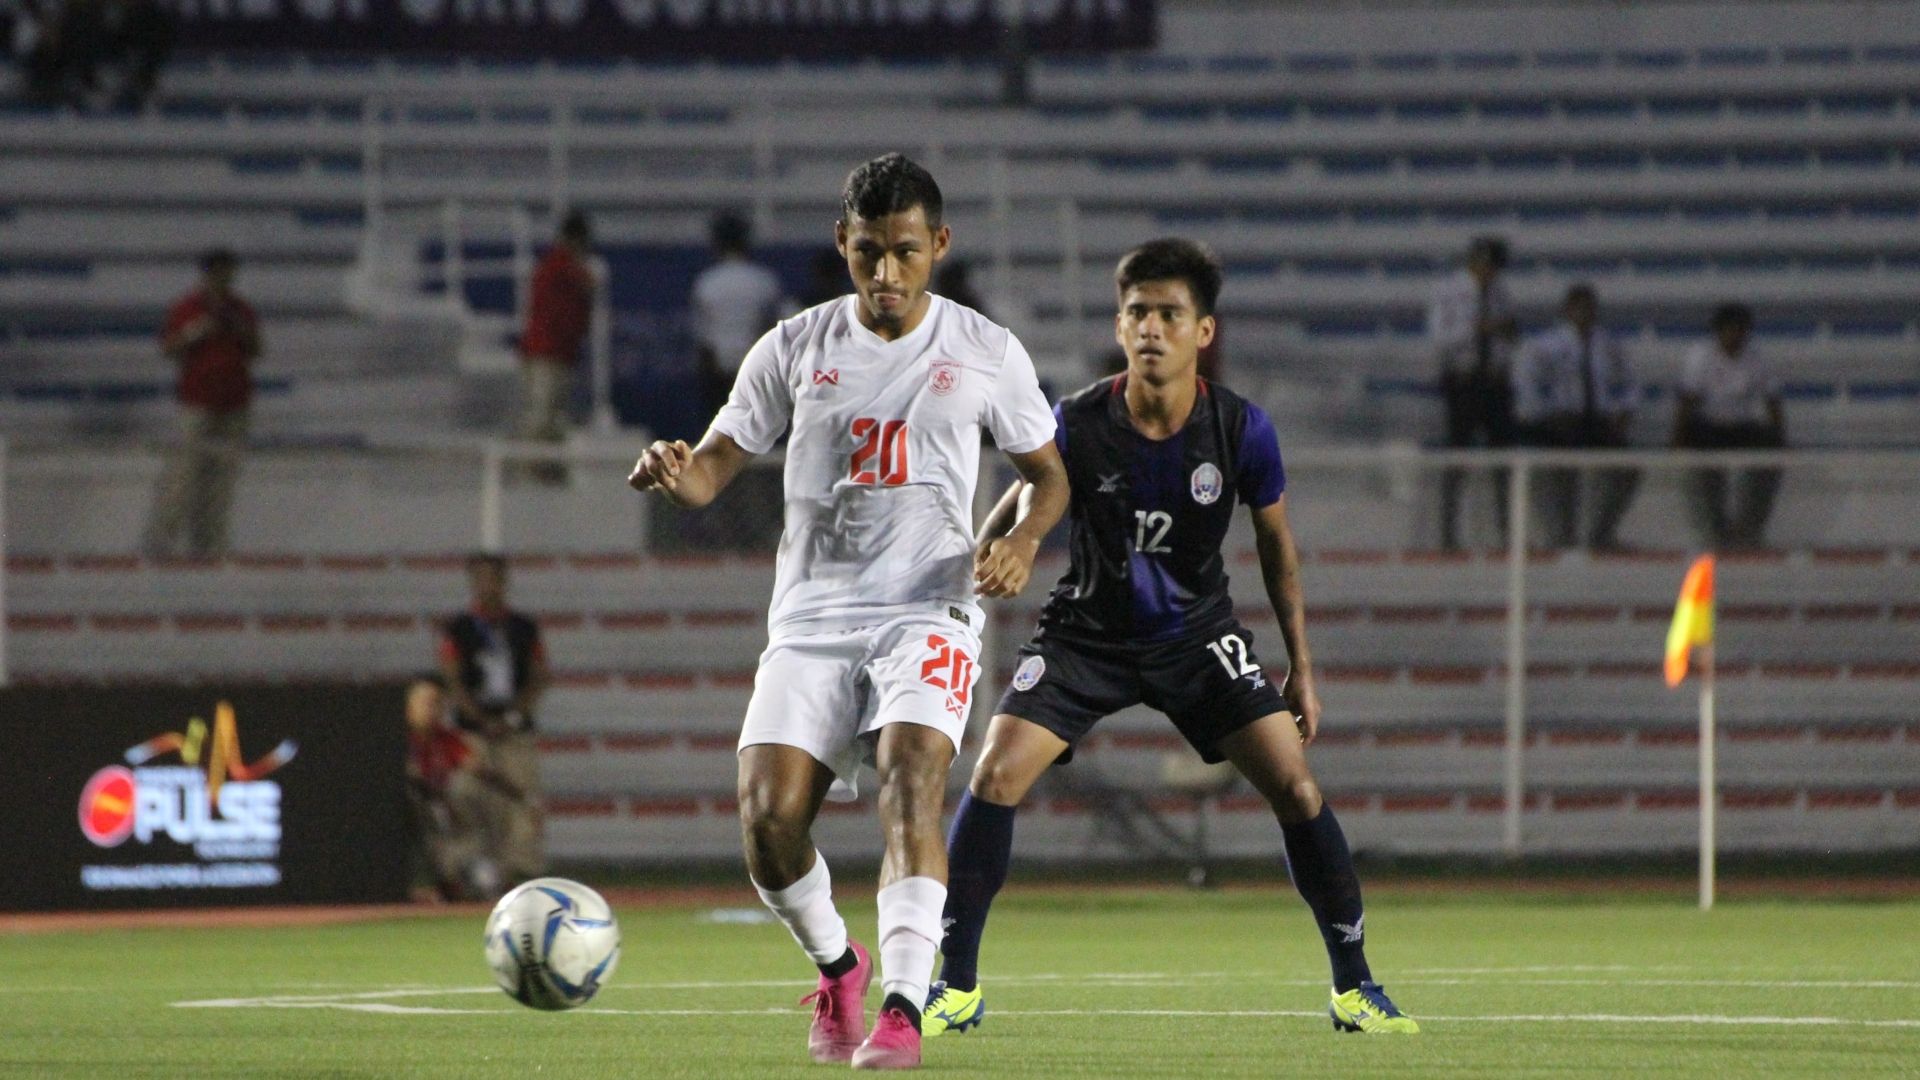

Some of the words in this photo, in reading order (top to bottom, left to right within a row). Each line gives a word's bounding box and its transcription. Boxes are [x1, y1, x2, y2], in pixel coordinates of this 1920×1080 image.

[850, 417, 908, 486] 20
[1134, 510, 1173, 552] 12
[920, 633, 973, 705] 20
[1206, 633, 1261, 680] 12
[134, 778, 282, 843] PULSE
